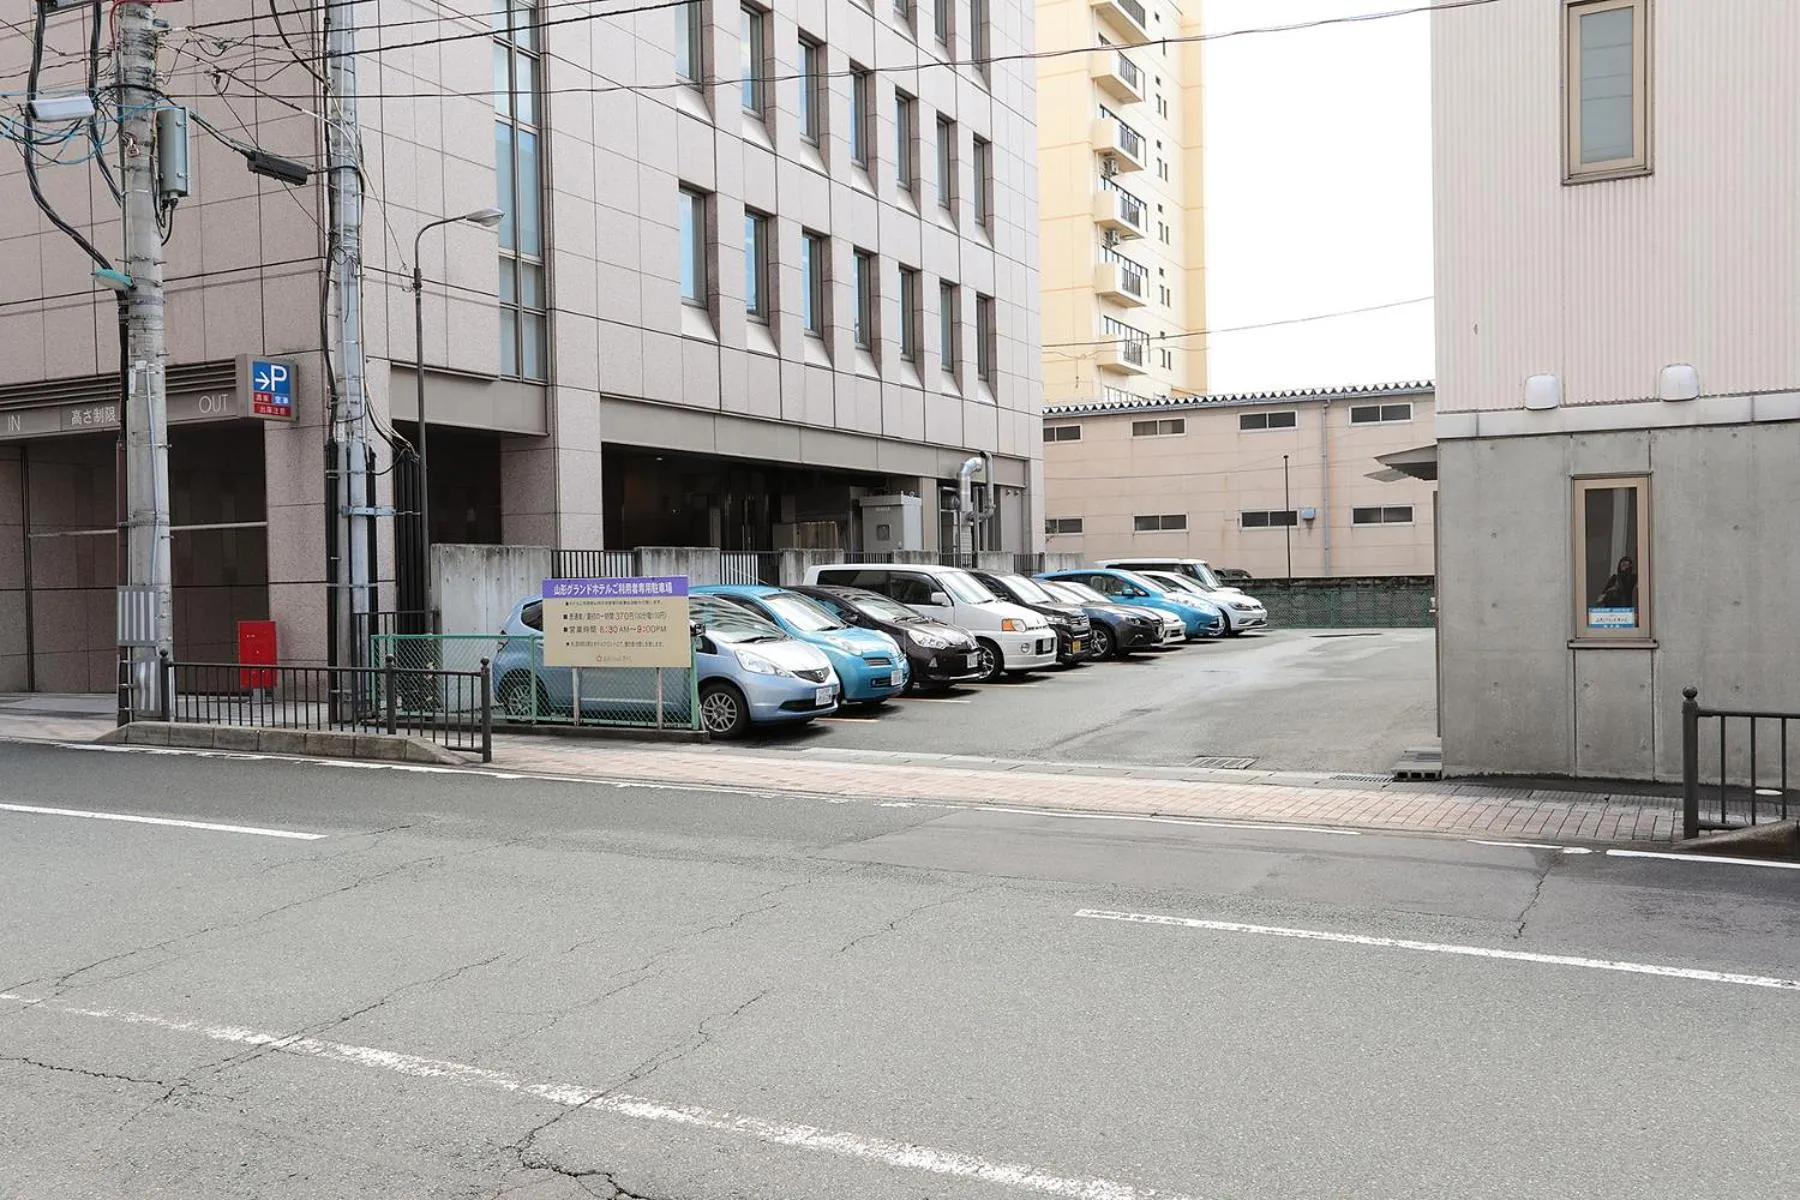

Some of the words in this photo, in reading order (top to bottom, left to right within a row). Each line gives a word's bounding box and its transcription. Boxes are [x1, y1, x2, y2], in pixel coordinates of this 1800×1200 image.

[271, 364, 288, 392] P
[198, 394, 229, 414] OUT
[8, 415, 21, 432] IN
[71, 406, 116, 426] 高さ制限
